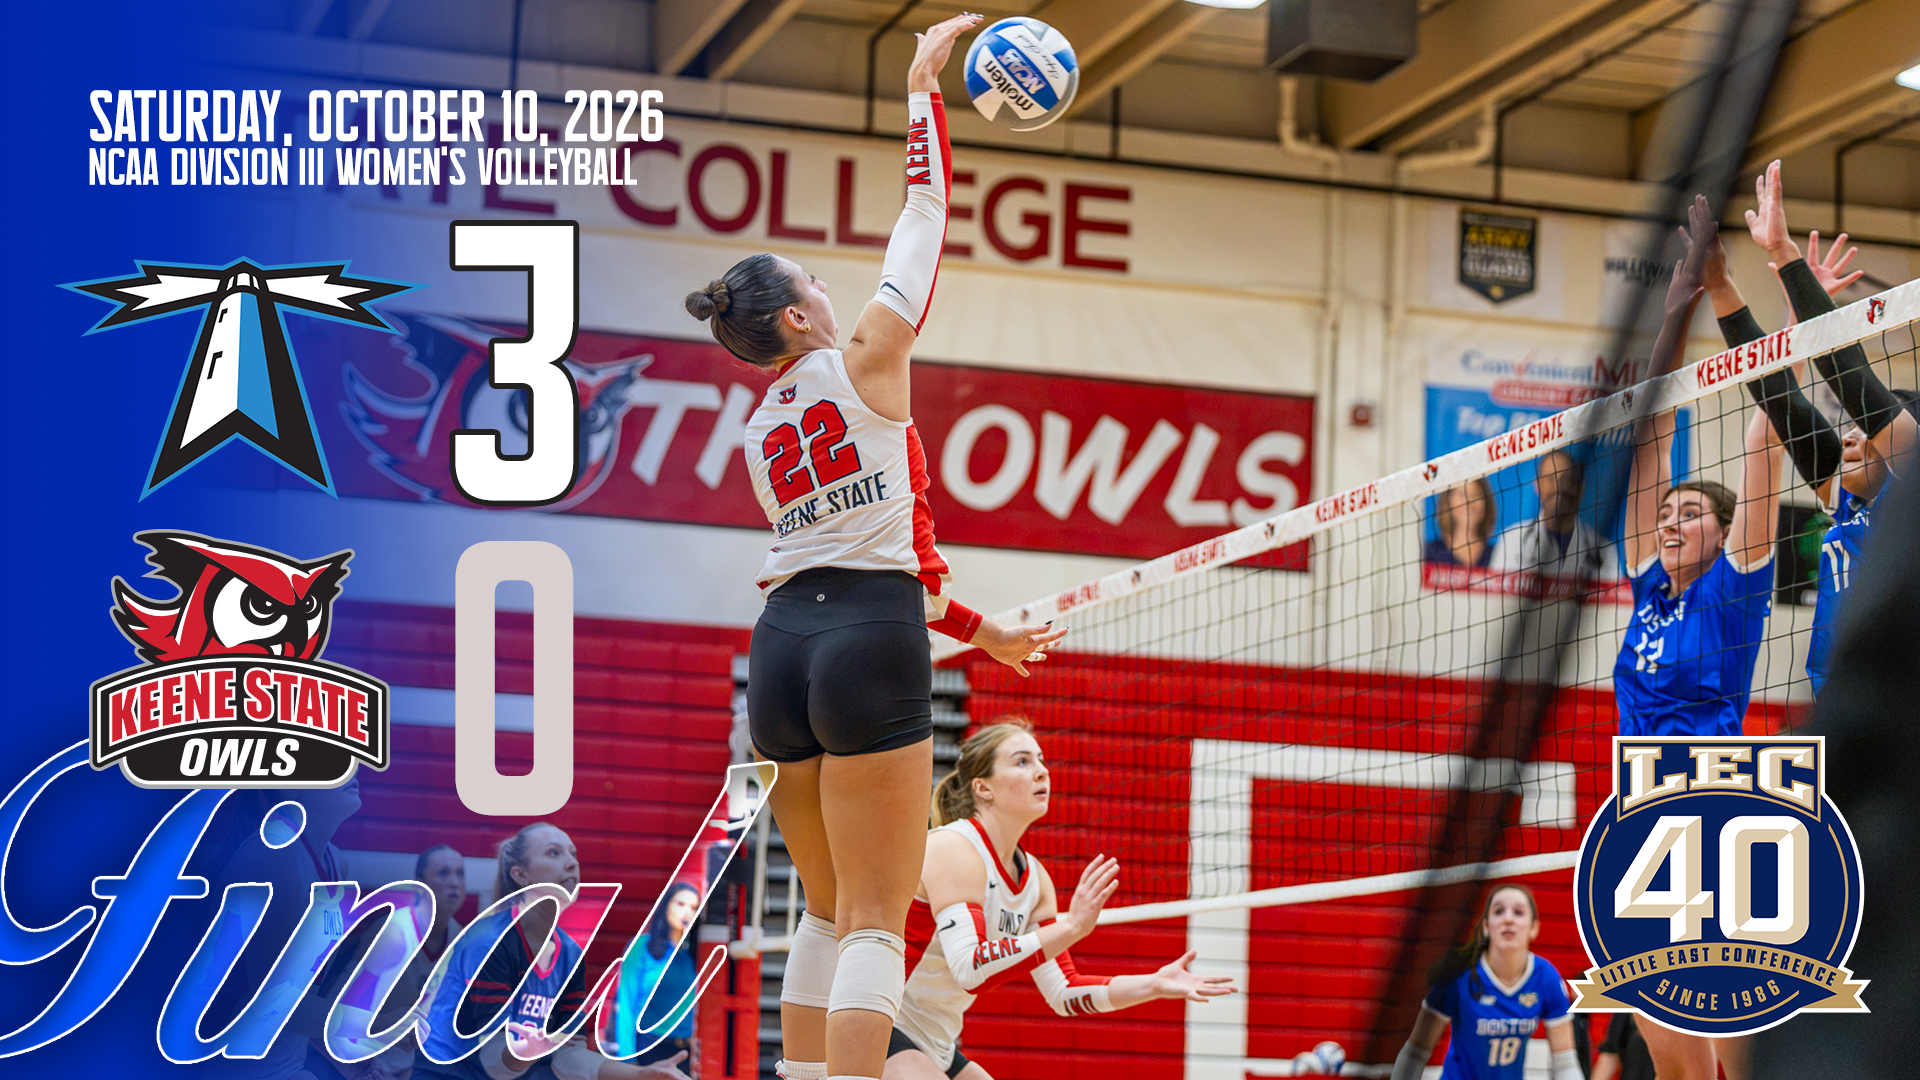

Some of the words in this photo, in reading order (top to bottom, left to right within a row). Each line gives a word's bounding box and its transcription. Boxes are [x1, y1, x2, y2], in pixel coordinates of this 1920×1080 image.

[983, 60, 1034, 111] molten
[997, 47, 1047, 95] NCAA
[907, 115, 932, 186] KEENE
[1696, 345, 1742, 389] KEENE
[1747, 328, 1794, 370] STATE
[762, 399, 863, 509] 22
[1486, 427, 1524, 462] KEENE
[1528, 414, 1564, 449] STATE
[941, 404, 1306, 528] OWLS
[826, 471, 890, 515] STATE
[1349, 482, 1380, 513] STATE
[973, 936, 1022, 971] KEENE
[1488, 1036, 1522, 1067] 18
